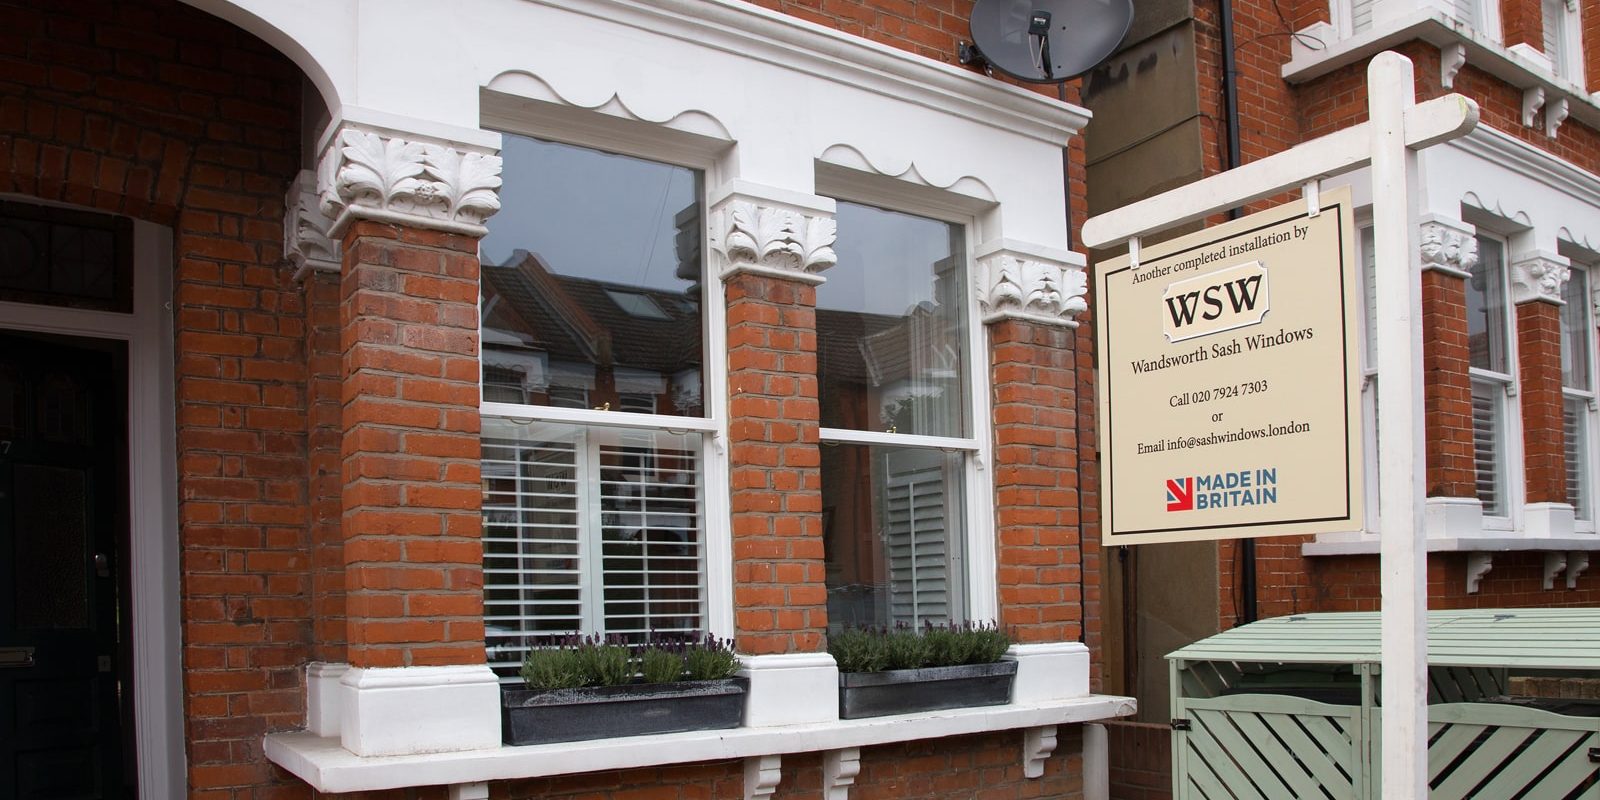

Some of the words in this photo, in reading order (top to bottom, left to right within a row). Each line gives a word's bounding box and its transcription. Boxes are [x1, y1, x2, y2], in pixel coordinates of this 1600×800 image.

[1132, 265, 1171, 284] Another
[1173, 247, 1226, 272] completed
[1228, 233, 1290, 256] installation
[1294, 226, 1308, 240] by
[1165, 274, 1262, 328] WSW
[1132, 346, 1208, 374] Wandsworth
[1212, 339, 1241, 358] Sash
[1244, 326, 1313, 350] Windows
[1170, 393, 1189, 407] Call
[1192, 390, 1210, 403] 020
[1214, 386, 1238, 399] 7924
[1242, 380, 1267, 395] 7303
[1212, 413, 1223, 422] or
[1, 440, 12, 454] 7
[1138, 440, 1164, 454] Email
[1168, 420, 1310, 450] info@sashwindows.london
[1196, 470, 1251, 491] MADE
[1257, 468, 1276, 485] IN
[1197, 486, 1276, 509] BRITAIN
